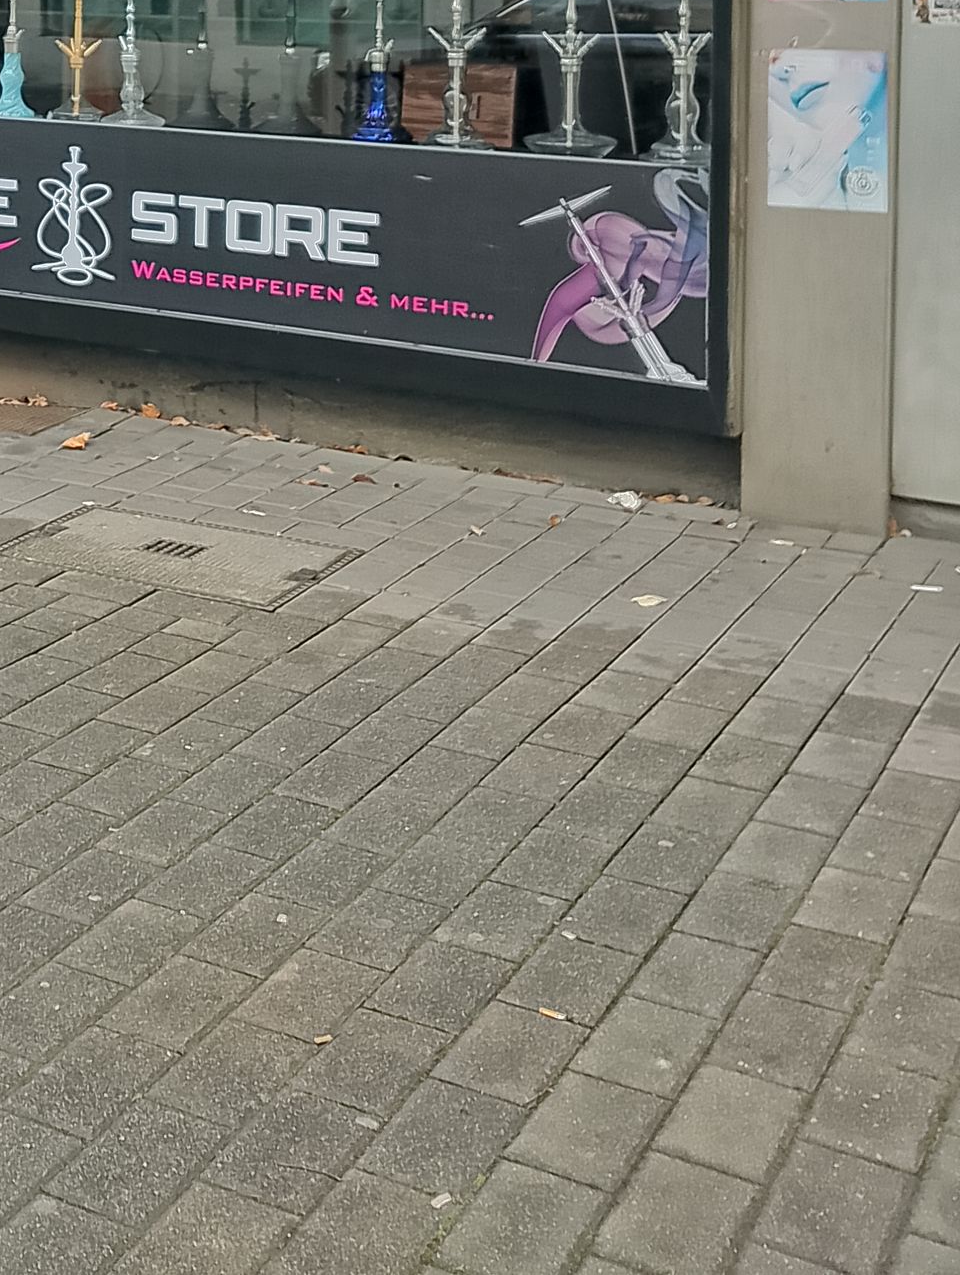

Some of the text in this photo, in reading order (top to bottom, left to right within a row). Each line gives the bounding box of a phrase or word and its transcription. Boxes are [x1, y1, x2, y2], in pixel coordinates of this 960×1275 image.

[130, 189, 381, 268] STORE
[130, 259, 344, 304] WASSERPFEIFEN
[355, 285, 379, 307] &
